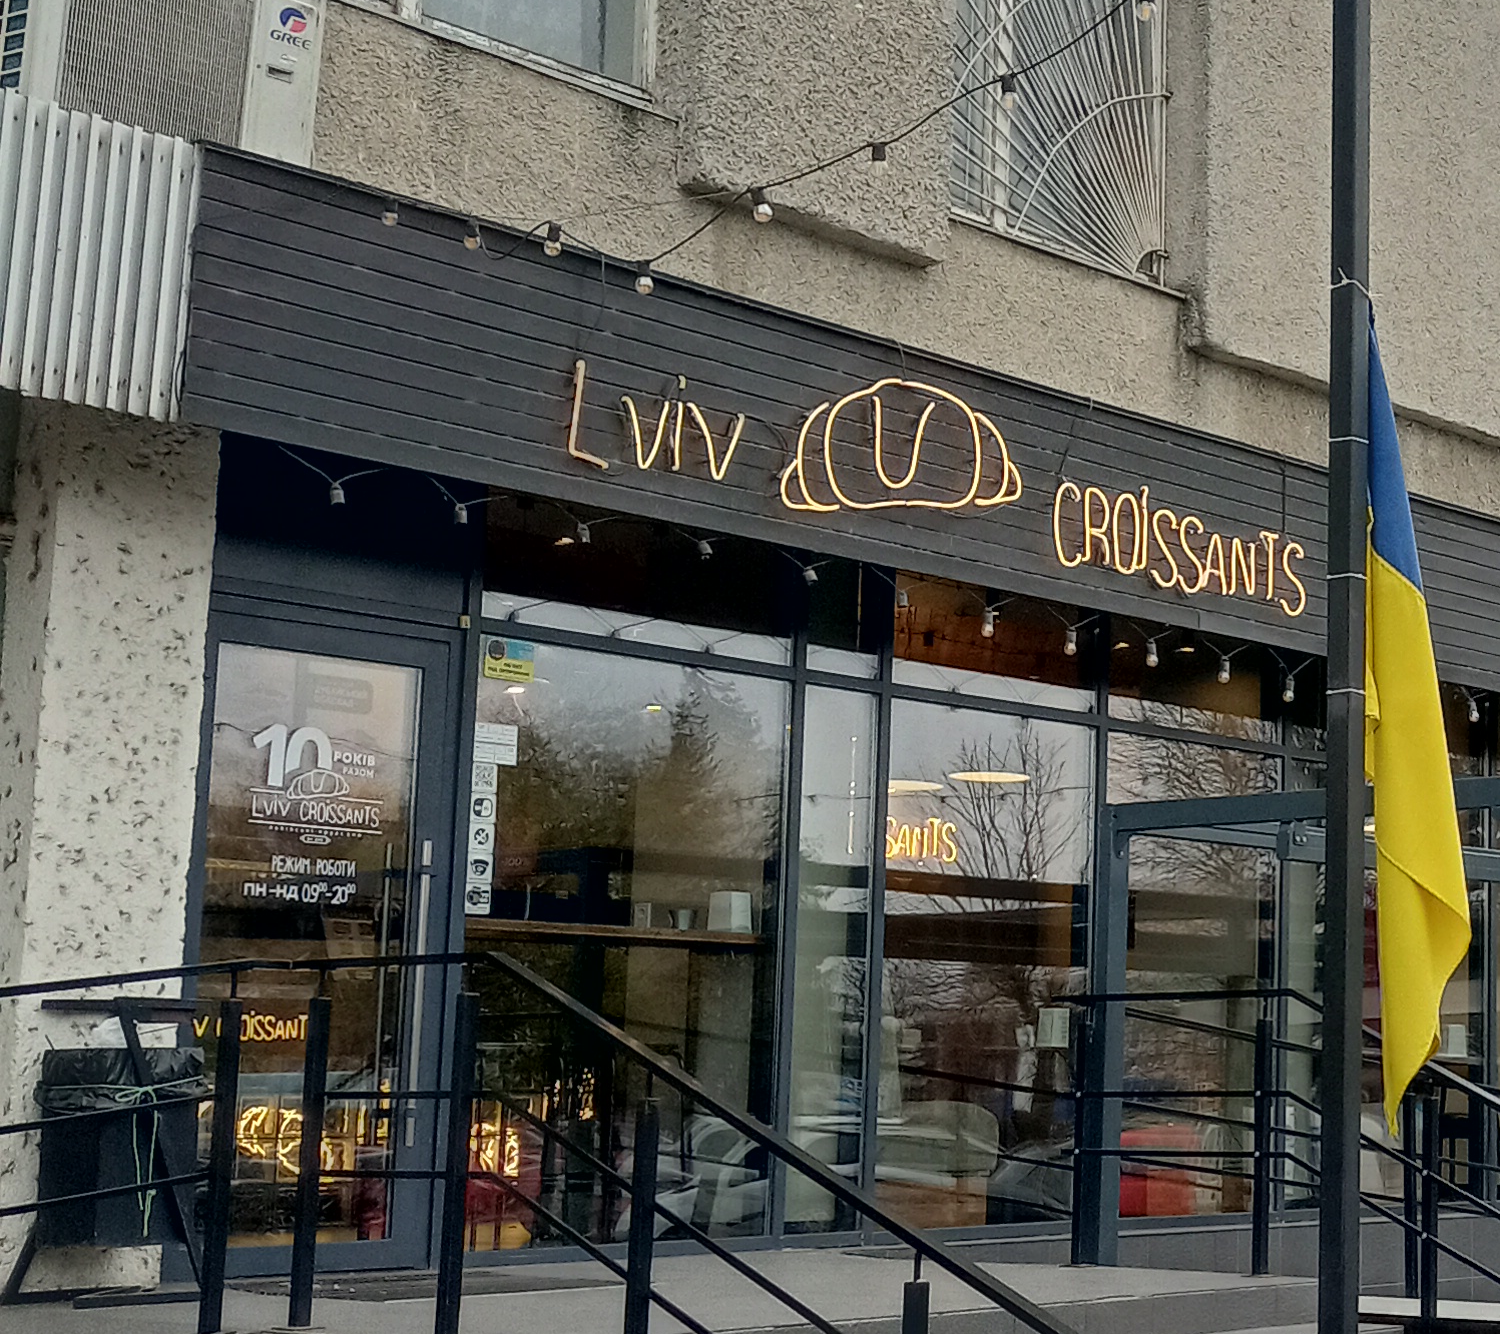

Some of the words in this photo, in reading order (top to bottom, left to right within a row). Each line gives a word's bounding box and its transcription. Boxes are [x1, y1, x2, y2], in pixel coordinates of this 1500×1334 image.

[270, 29, 312, 51] GREE
[252, 722, 333, 787] 10
[333, 750, 376, 767] РОКІВ
[342, 767, 375, 779] РАЗОМ
[271, 854, 311, 875] РЕЖИМ
[315, 857, 357, 878] РОБОТИ
